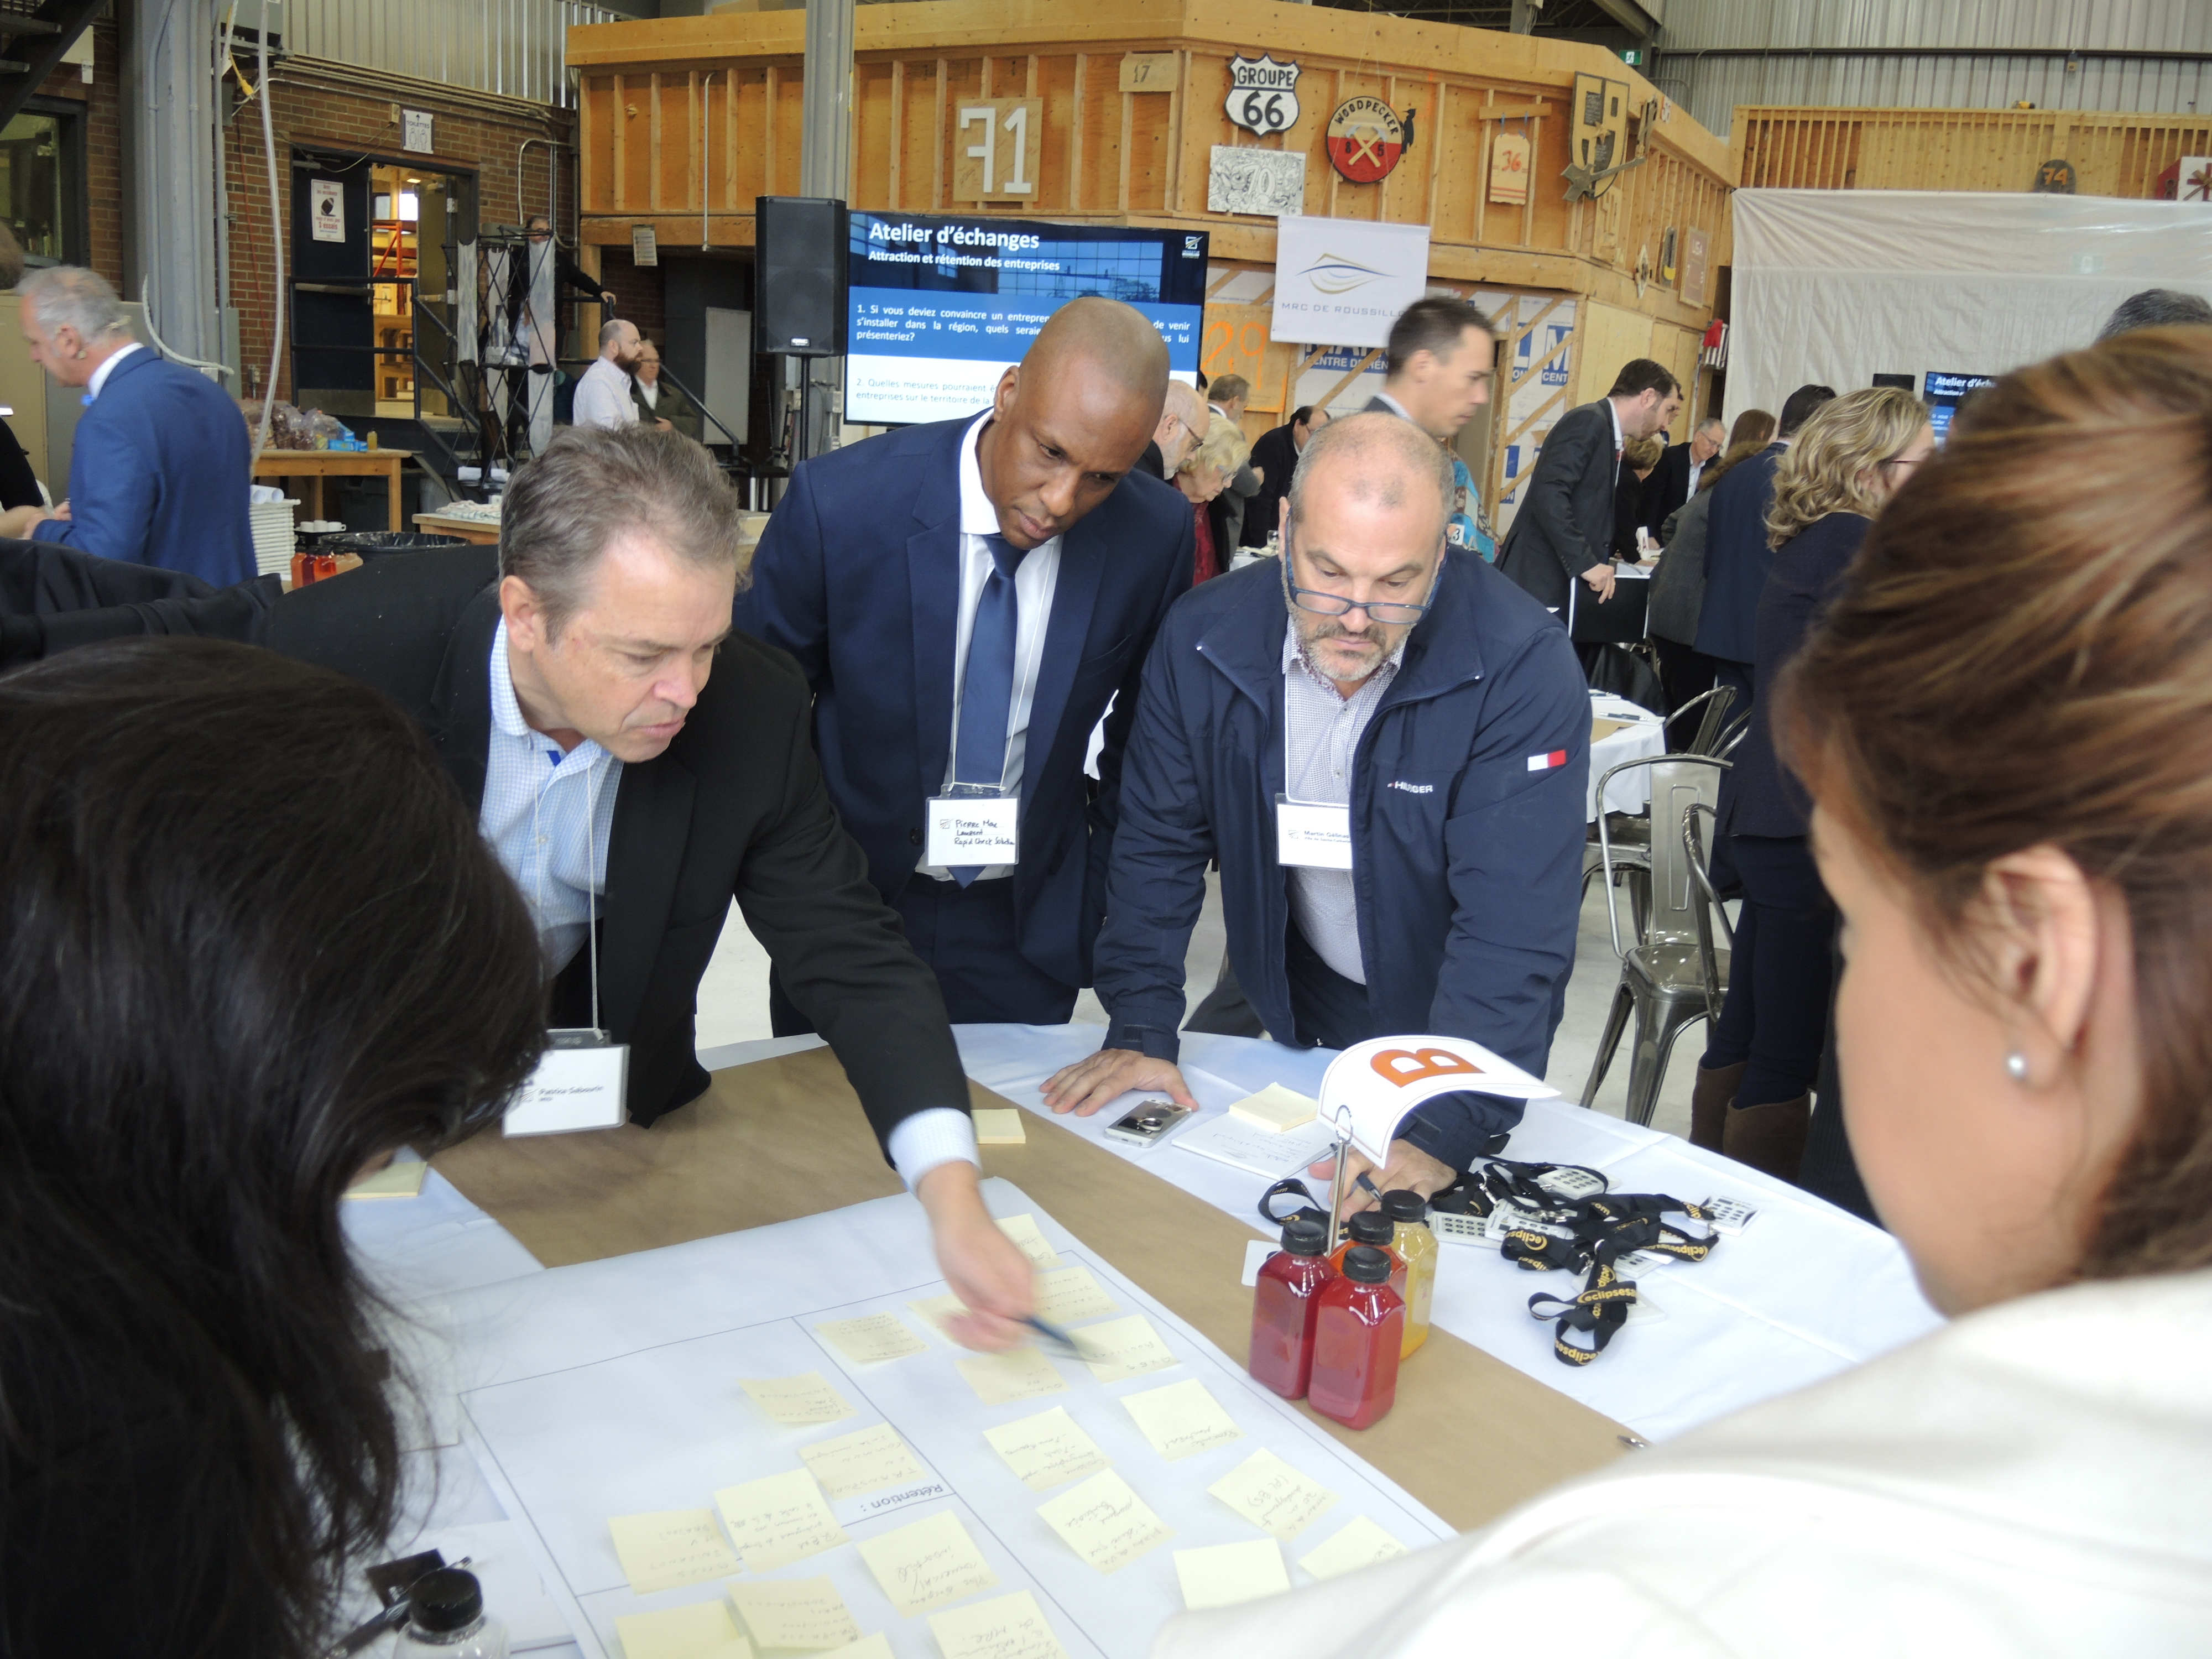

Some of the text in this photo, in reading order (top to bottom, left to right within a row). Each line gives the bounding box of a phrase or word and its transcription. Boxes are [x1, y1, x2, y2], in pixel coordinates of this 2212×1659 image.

[1238, 66, 1294, 87] GROUPE
[1243, 90, 1284, 128] 66
[1334, 100, 1399, 135] WOODPECKER
[407, 121, 430, 129] TOILETTES
[1501, 150, 1522, 172] 36
[2042, 167, 2069, 186] 74
[869, 223, 1040, 251] Atelier d'échanges
[868, 251, 1060, 272] Attraction et rétention des entreprises
[857, 305, 865, 314] 1.
[870, 305, 879, 314] Si
[883, 307, 904, 316] vous
[908, 306, 936, 317] deviez
[940, 310, 987, 320] convaincre
[1008, 312, 1050, 324] entrepren
[1154, 320, 1165, 330] de
[1168, 321, 1191, 331] venir
[1282, 302, 1401, 317] MRC DE ROUSSILLO
[857, 318, 898, 328] s'installer
[905, 320, 926, 330] dans
[933, 321, 942, 331] la
[948, 322, 979, 333] région,
[985, 324, 1009, 335] quels
[1178, 334, 1190, 343] lui
[857, 330, 916, 342] présenteriez?
[856, 378, 864, 387] 2.
[868, 378, 899, 388] Quelles
[904, 382, 938, 390] mesures
[942, 383, 986, 393] pourraient
[1542, 371, 1568, 383] CENT
[1934, 377, 1967, 387] Atelier
[856, 392, 990, 405] entreprises sur le territoire de la
[1370, 1047, 1488, 1088] B
[870, 1484, 944, 1510] Rétention
